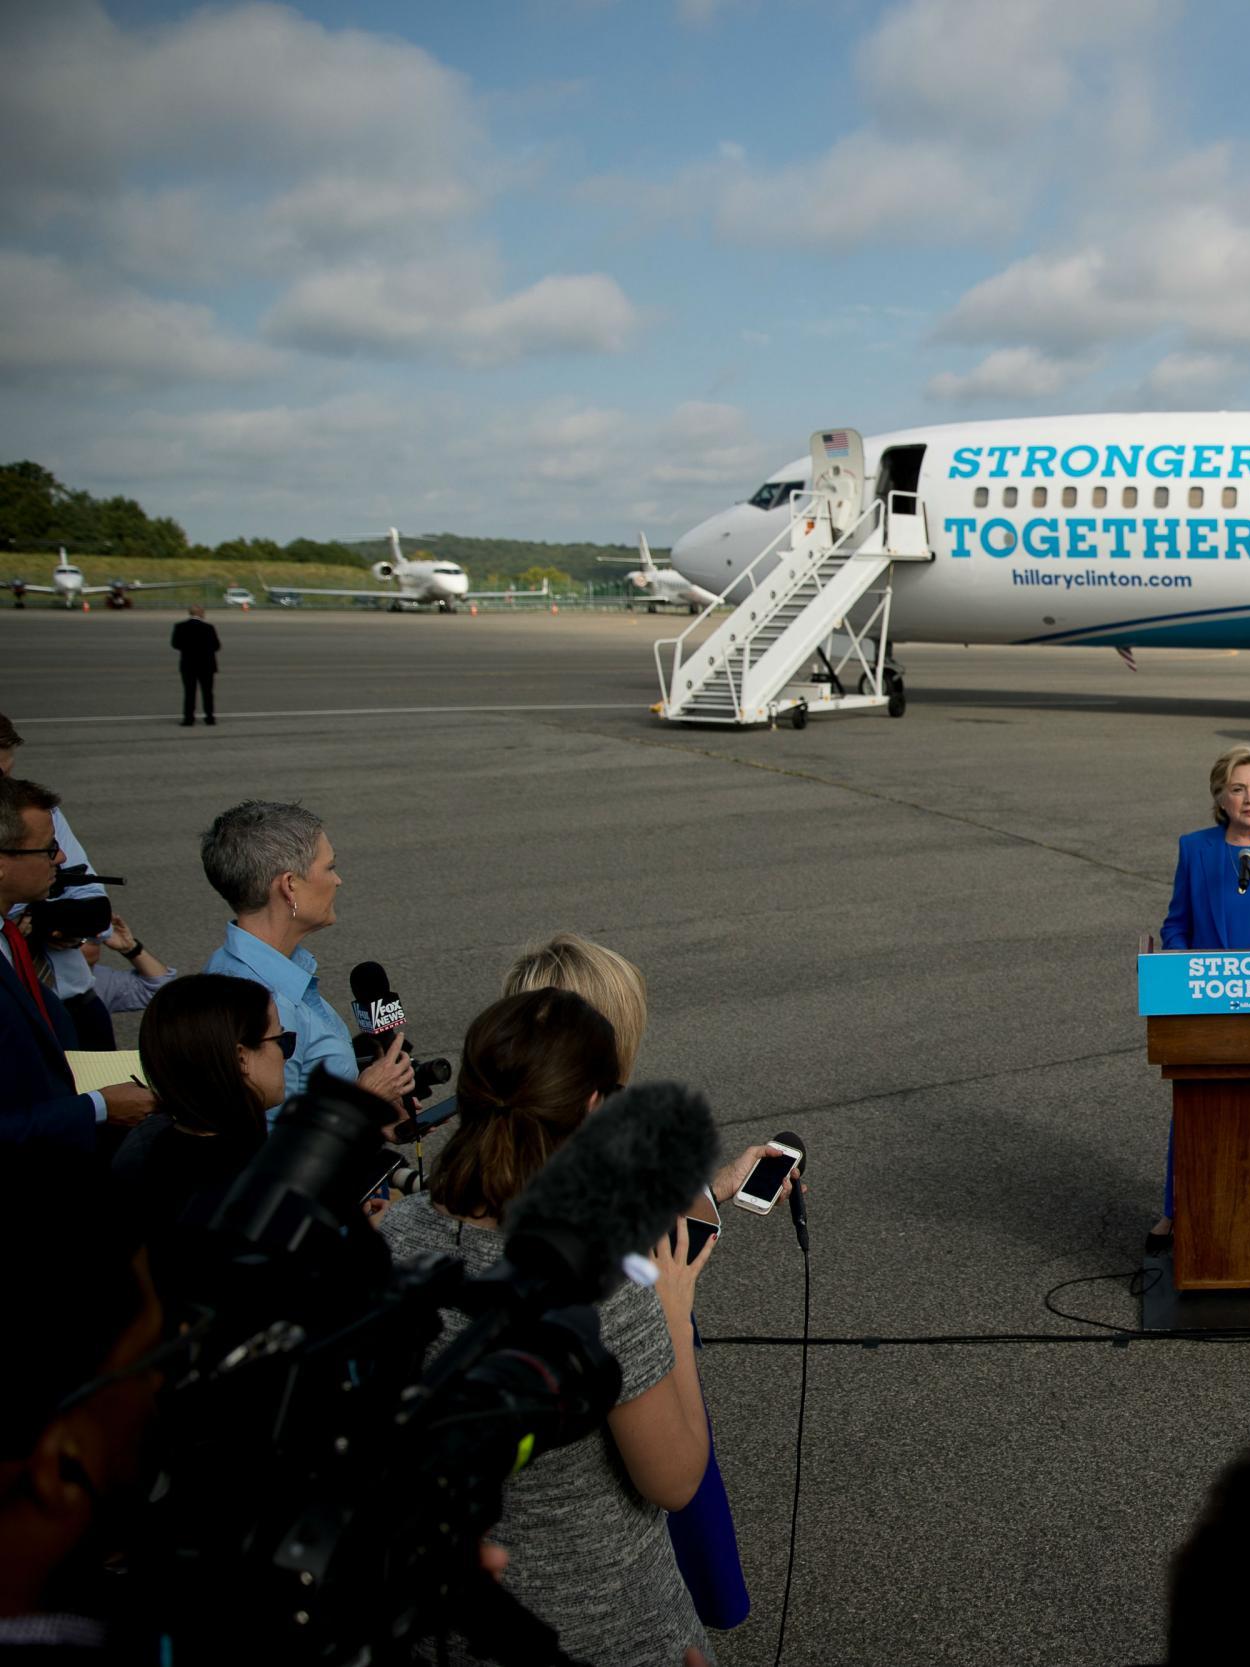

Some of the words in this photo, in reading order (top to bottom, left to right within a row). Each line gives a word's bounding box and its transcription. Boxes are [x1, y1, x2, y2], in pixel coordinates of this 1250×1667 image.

[1012, 568, 1193, 590] hillaryclinton.com
[379, 999, 403, 1016] FOX
[375, 1009, 405, 1028] NEWS
